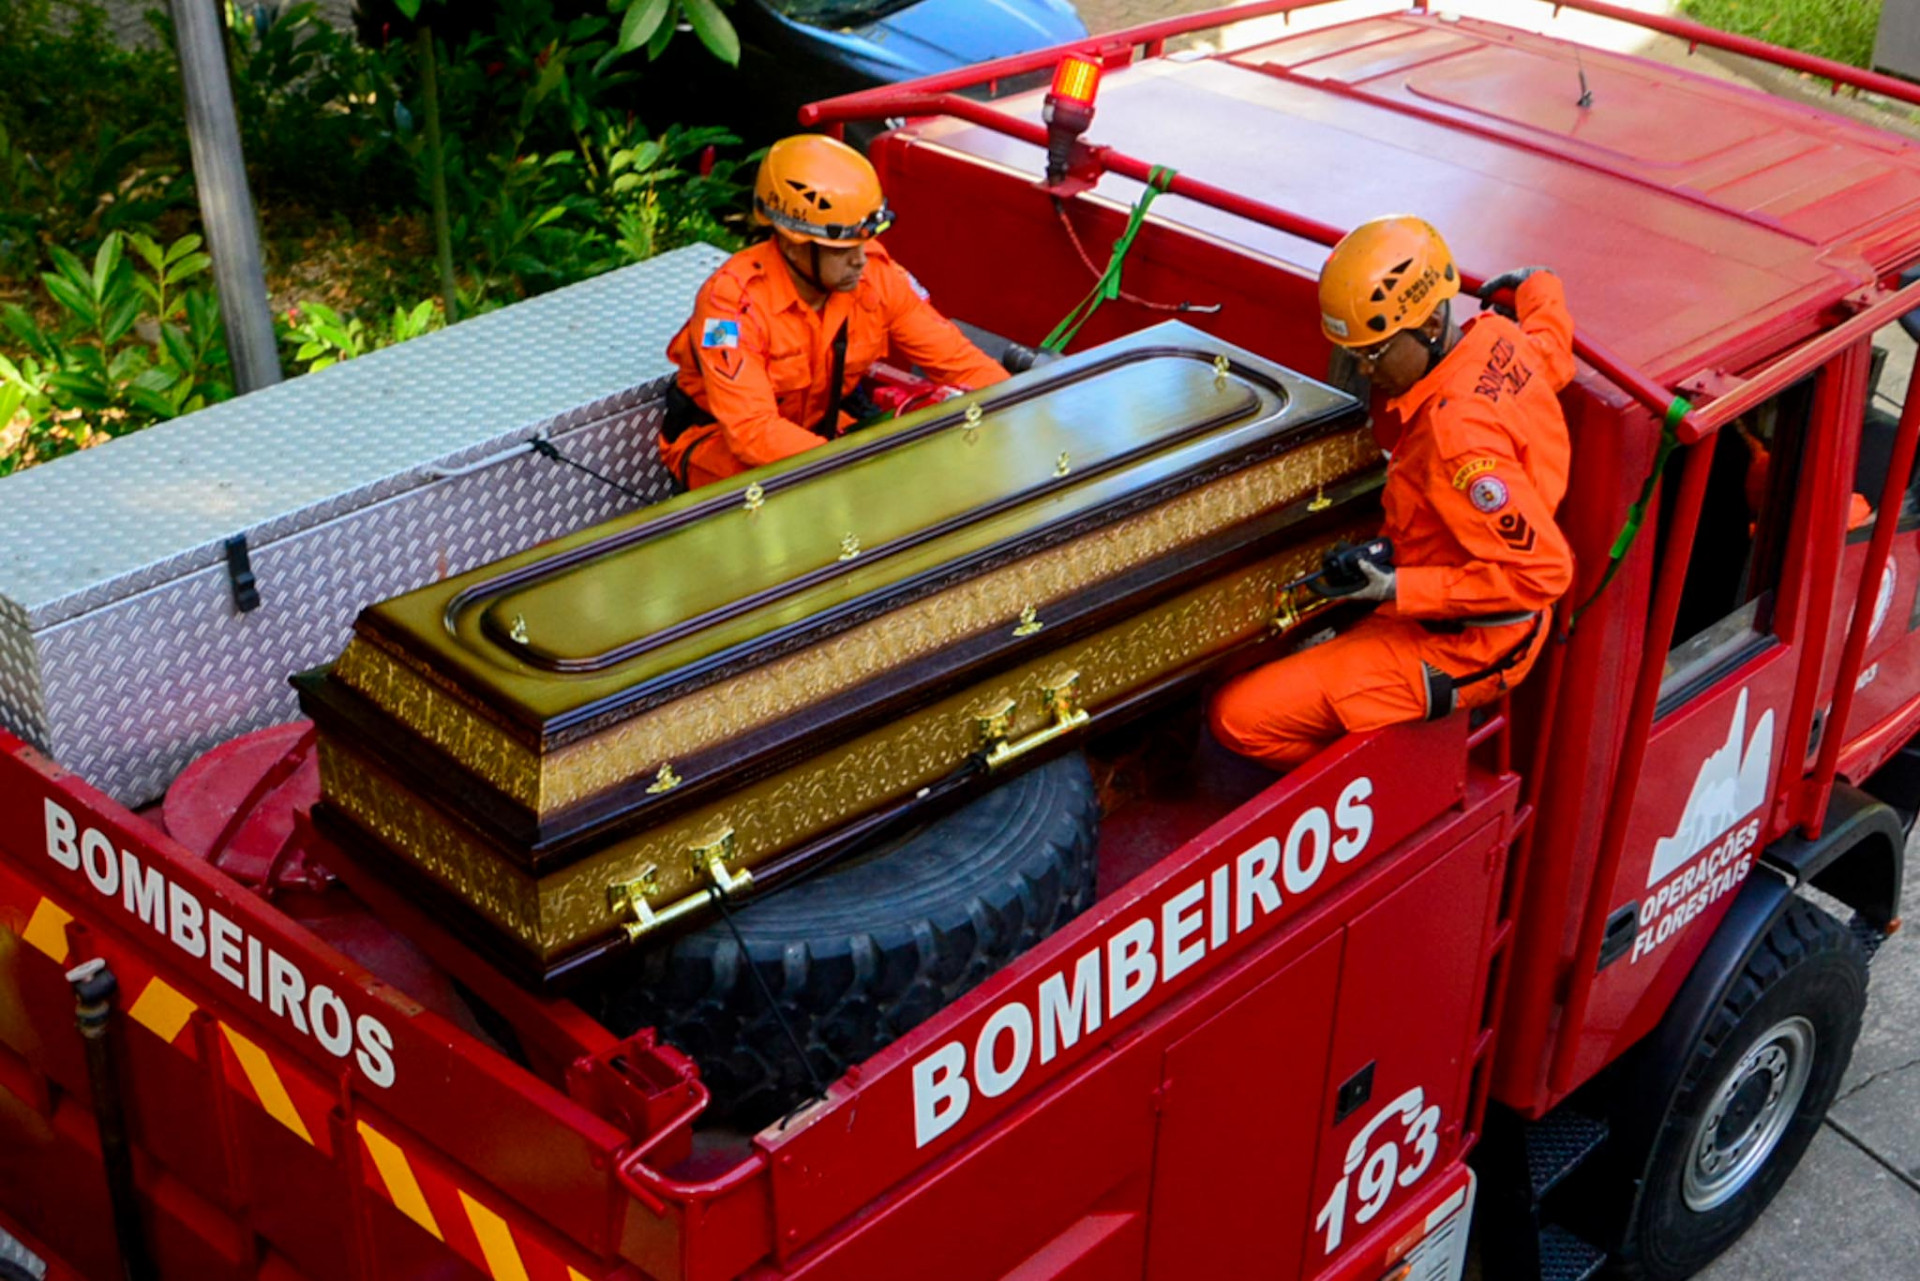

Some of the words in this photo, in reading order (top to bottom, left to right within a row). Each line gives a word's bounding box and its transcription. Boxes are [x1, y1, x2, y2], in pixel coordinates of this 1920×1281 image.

[44, 797, 395, 1088] BOMBEIROS
[1630, 853, 1752, 965] FLORESTAIS
[1639, 818, 1760, 927] OPERAÇÕES
[912, 776, 1374, 1149] BOMBEIROS
[1315, 1104, 1441, 1255] 193
